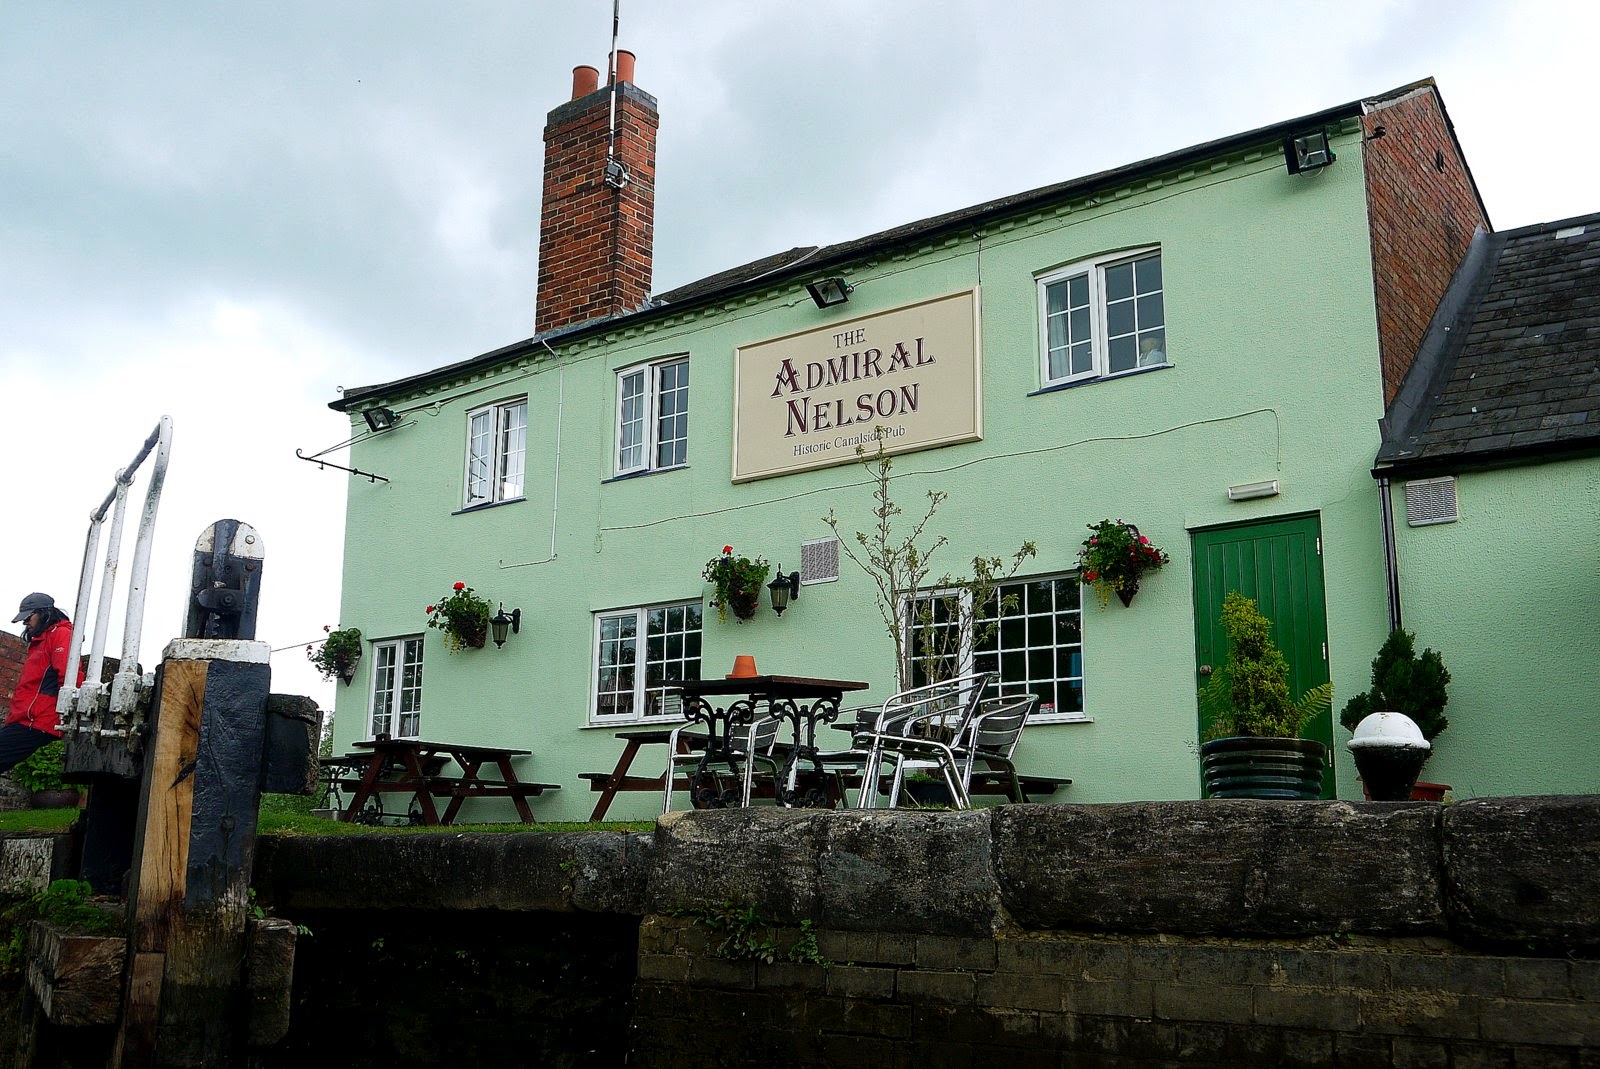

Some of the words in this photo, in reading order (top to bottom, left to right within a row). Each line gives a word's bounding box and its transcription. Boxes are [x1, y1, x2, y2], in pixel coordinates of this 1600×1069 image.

[833, 328, 866, 348] THE
[771, 338, 936, 398] ADMIRAL
[784, 383, 920, 438] NELSON
[793, 440, 832, 456] Historic
[885, 425, 906, 438] Pub
